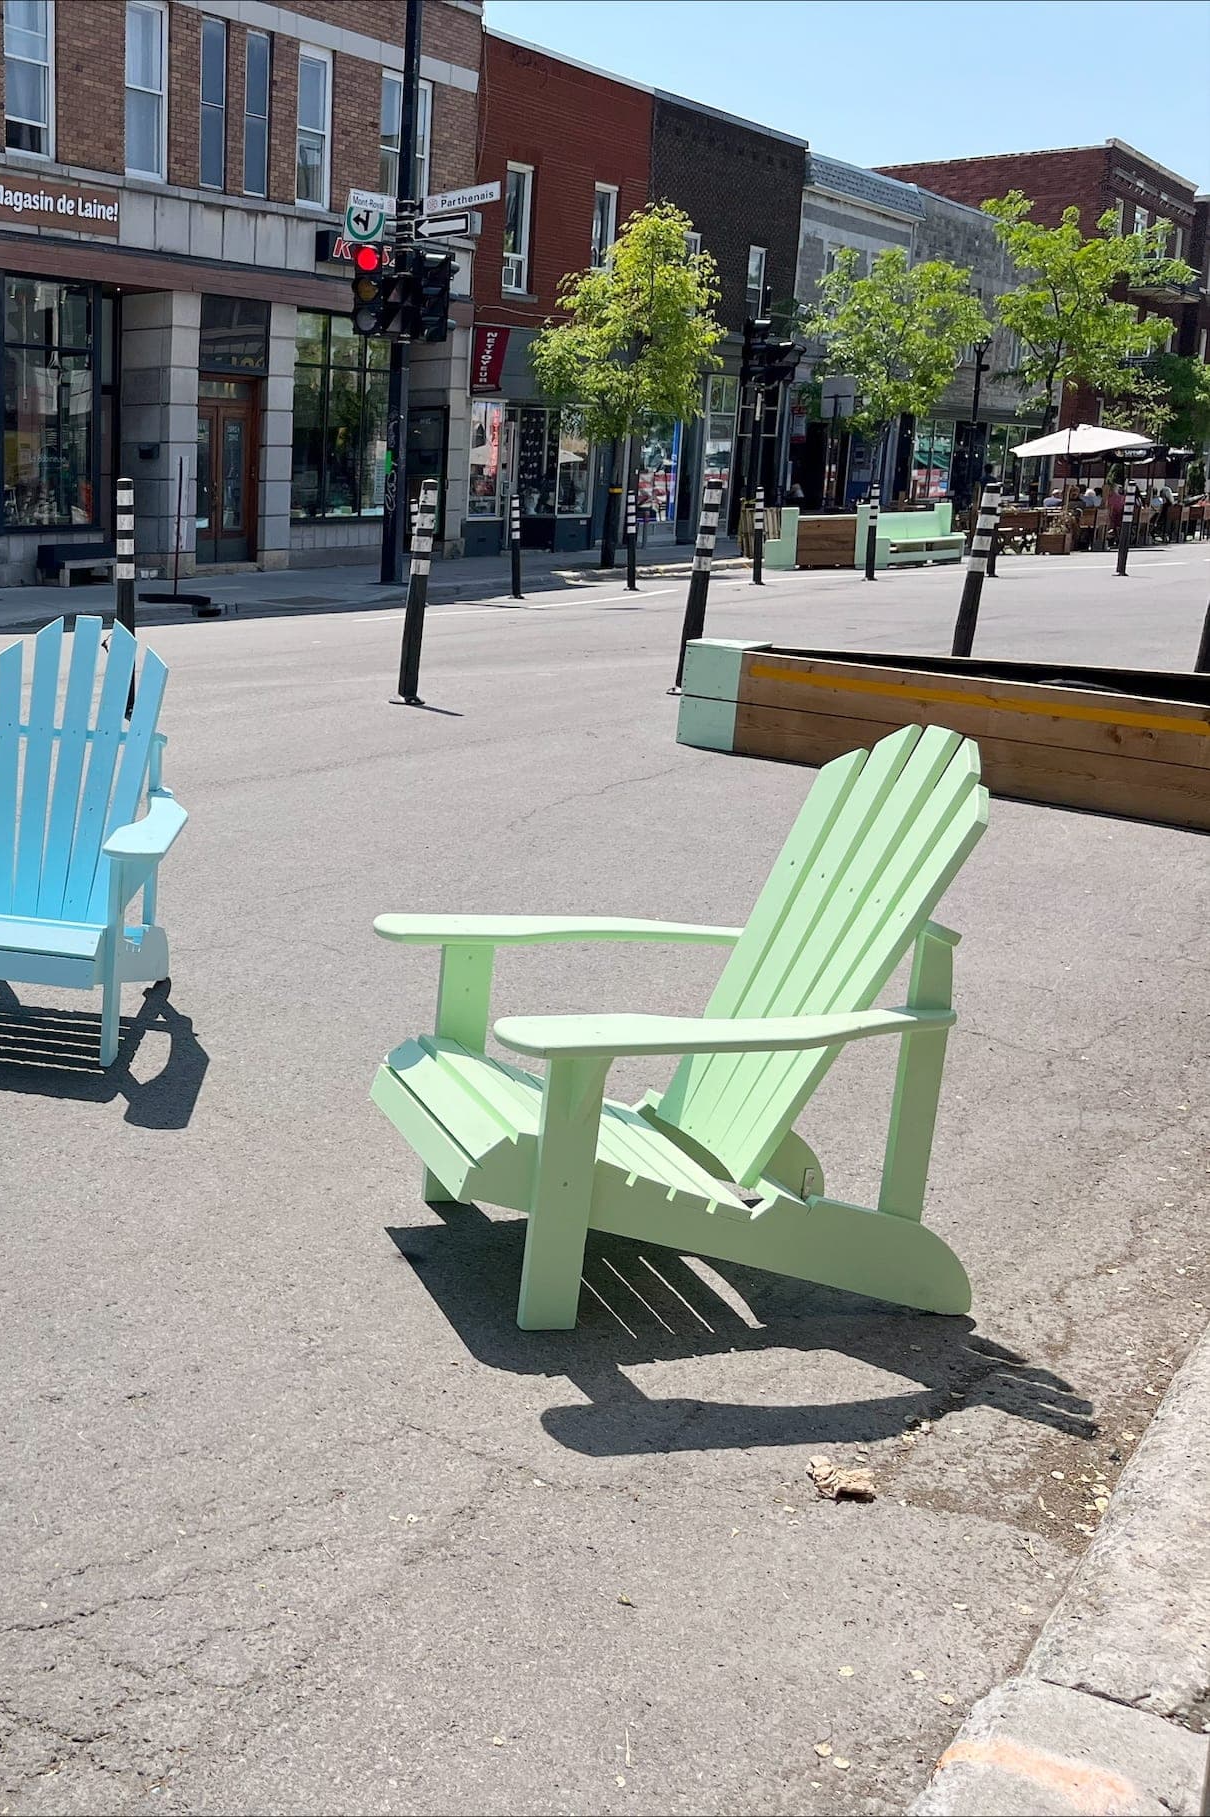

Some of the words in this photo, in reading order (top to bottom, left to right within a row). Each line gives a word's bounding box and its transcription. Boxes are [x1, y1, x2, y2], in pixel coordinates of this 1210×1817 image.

[56, 194, 75, 216] de
[77, 197, 119, 222] Laine!
[440, 190, 494, 208] Parthenais
[478, 331, 498, 383] NETTOYEUR
